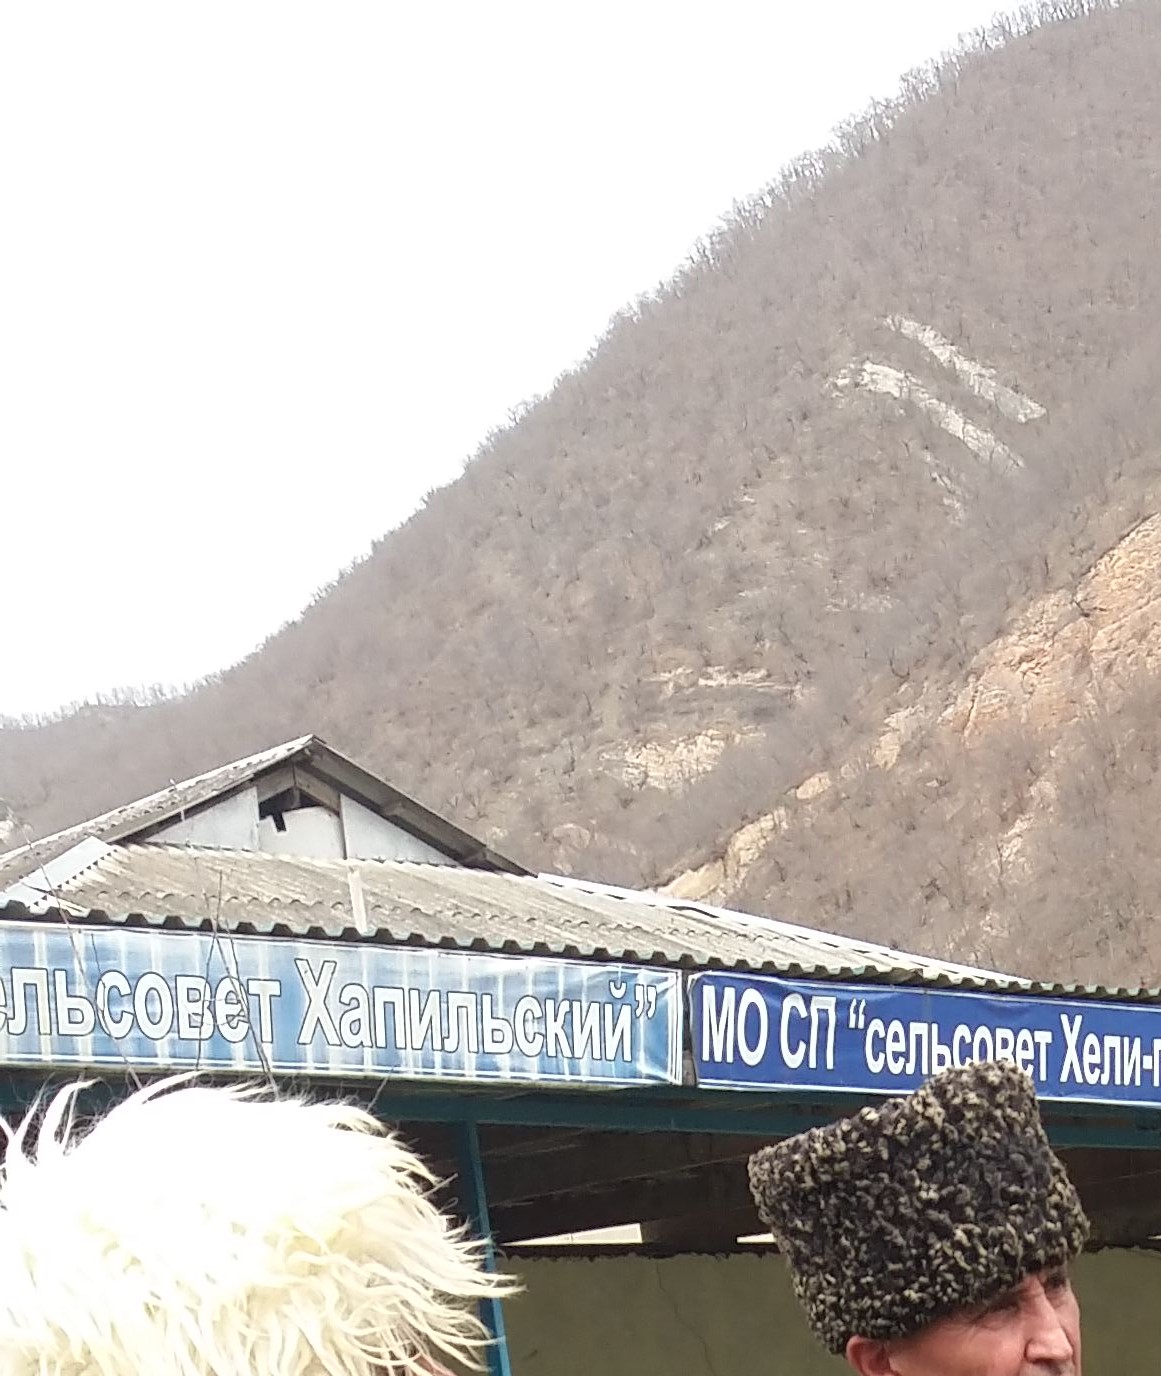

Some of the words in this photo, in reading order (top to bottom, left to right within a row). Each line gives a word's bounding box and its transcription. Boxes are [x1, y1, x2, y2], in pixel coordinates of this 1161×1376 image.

[0, 967, 281, 1044] льсовет
[294, 958, 657, 1062] Хапильский”
[701, 984, 768, 1066] МО
[779, 995, 836, 1070] СП
[848, 998, 1053, 1082] “сельсовет
